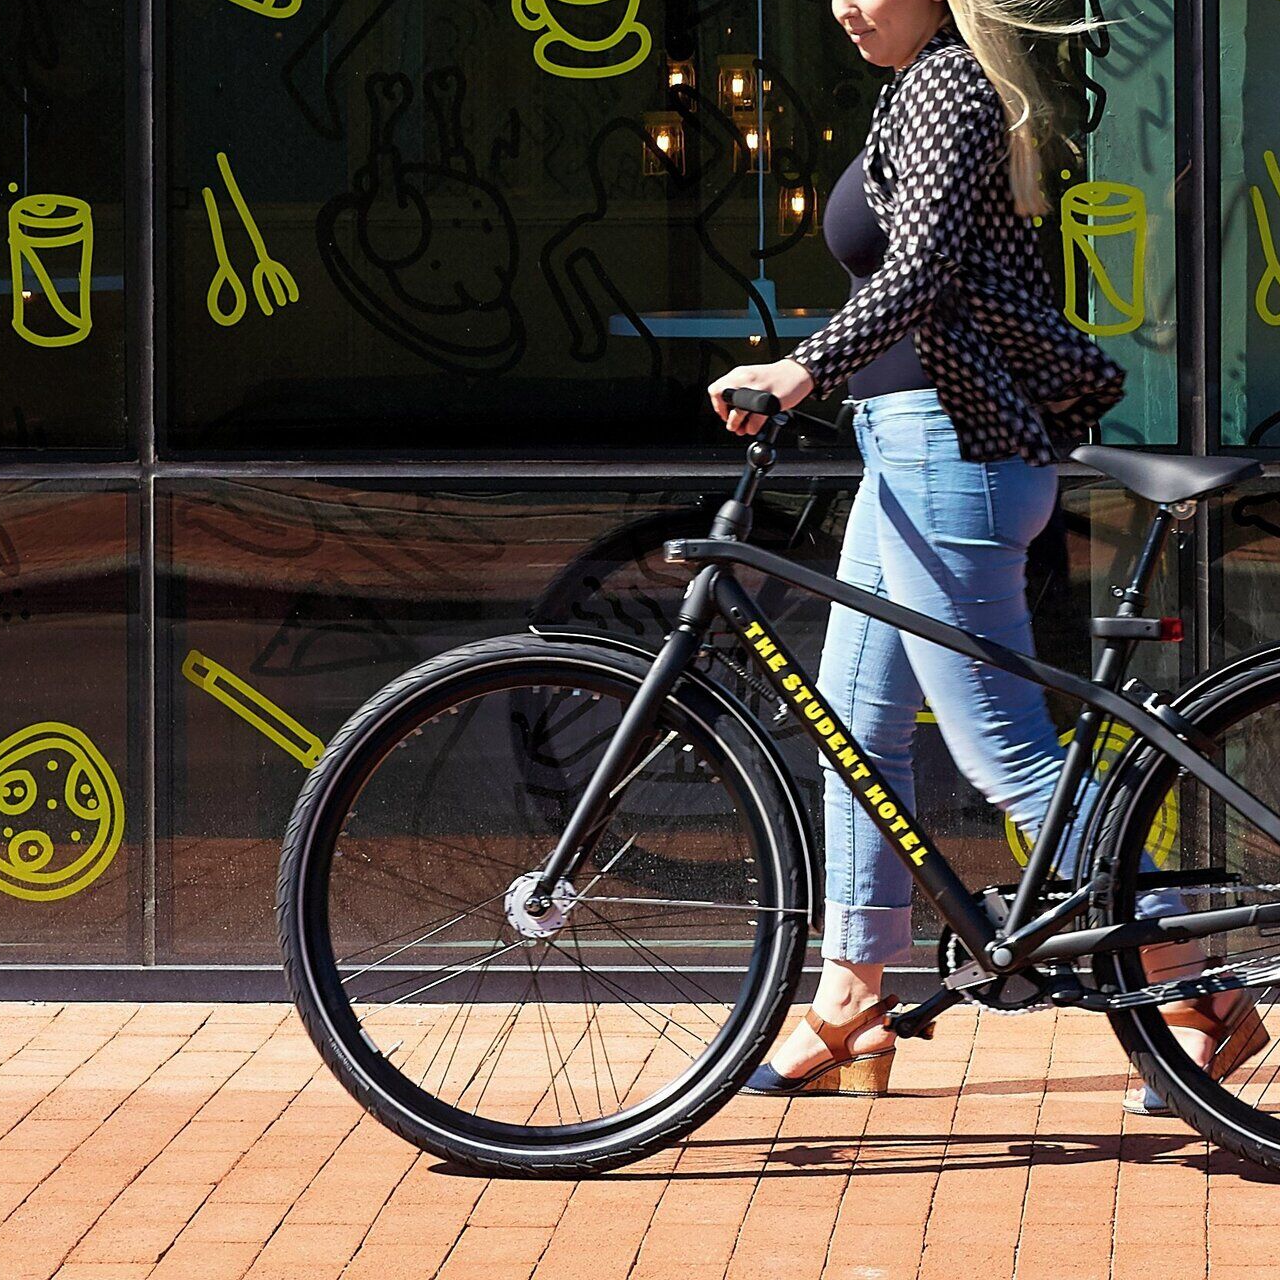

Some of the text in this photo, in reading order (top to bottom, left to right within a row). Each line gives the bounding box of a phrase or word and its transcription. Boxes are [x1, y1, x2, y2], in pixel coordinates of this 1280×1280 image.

[744, 621, 929, 867] THE STUDENT HOTEL
